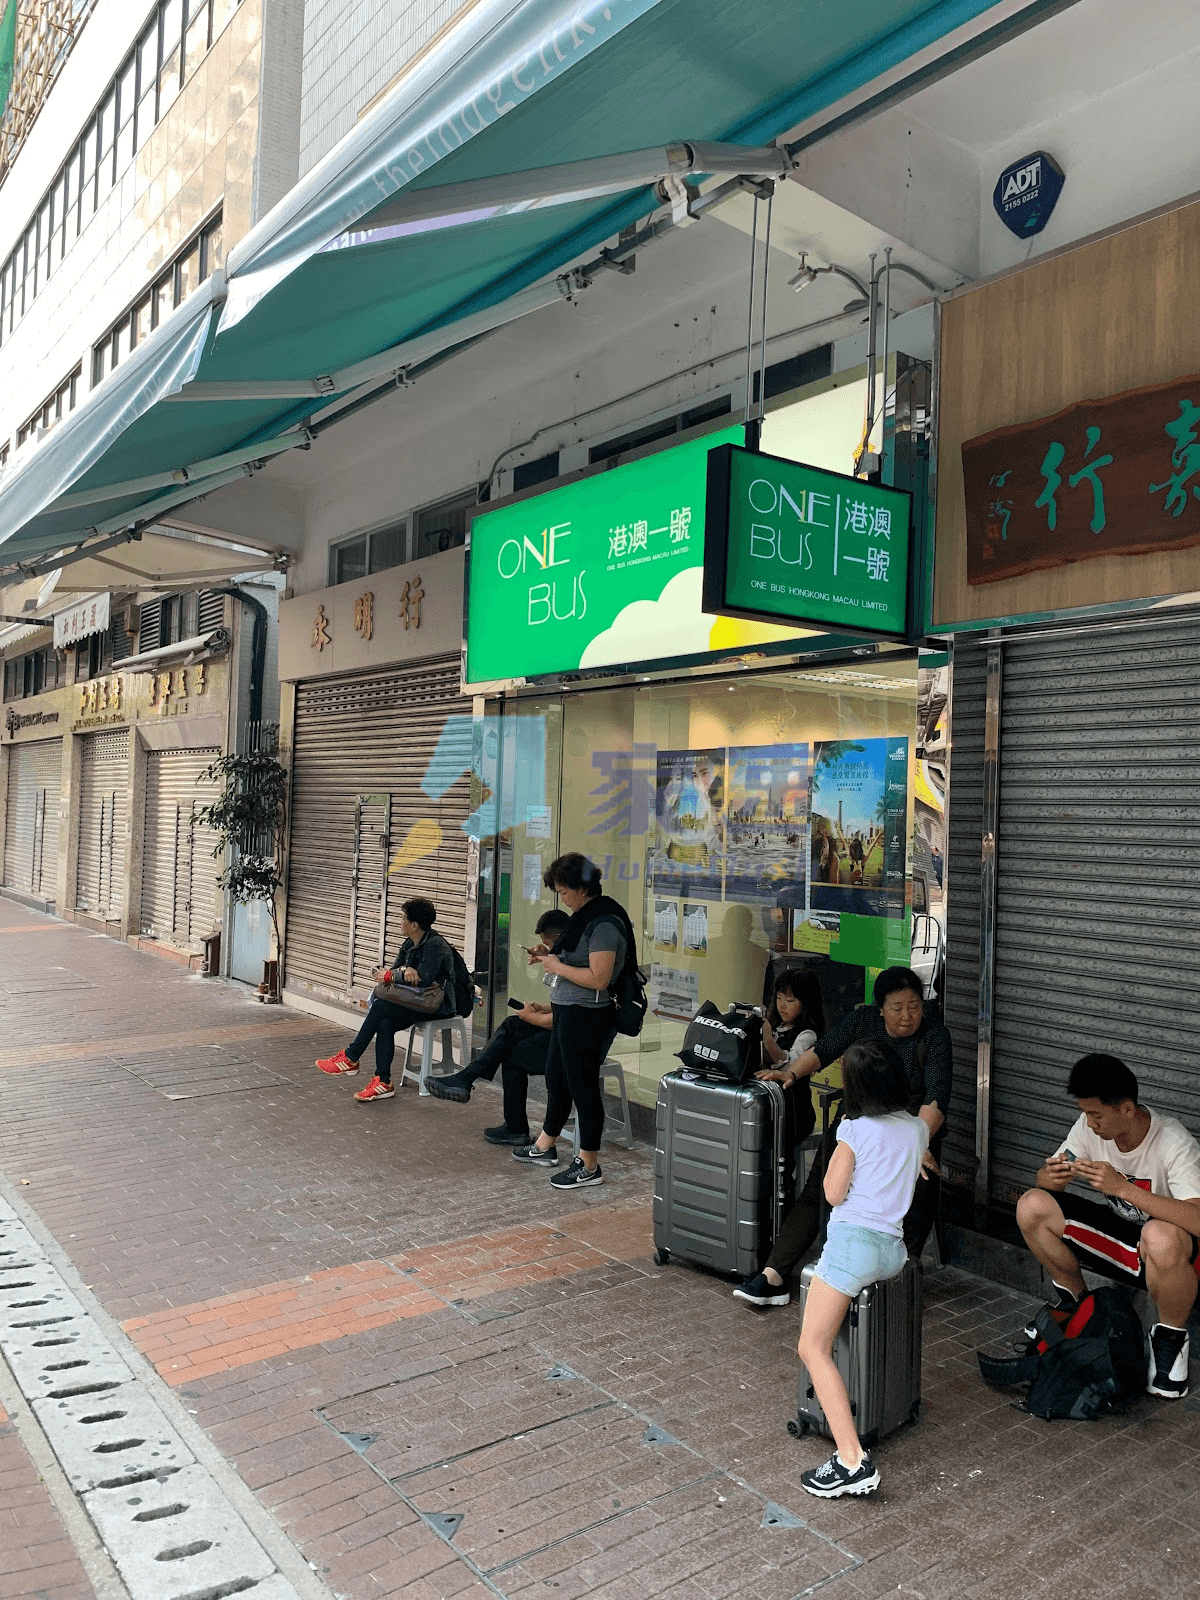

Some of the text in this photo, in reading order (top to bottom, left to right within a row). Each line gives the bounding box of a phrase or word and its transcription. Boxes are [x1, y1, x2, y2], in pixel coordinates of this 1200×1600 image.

[1002, 161, 1040, 202] ADT
[1004, 190, 1039, 212] 2155 0222
[607, 506, 693, 560] 港澳一號
[843, 498, 892, 541] 港澳
[750, 523, 813, 571] BUS
[842, 546, 891, 582] 一號
[310, 576, 426, 652] 永明行
[527, 569, 588, 626] BUS
[750, 580, 889, 612] ONE BUS HONGKONG MACAU LIMITED
